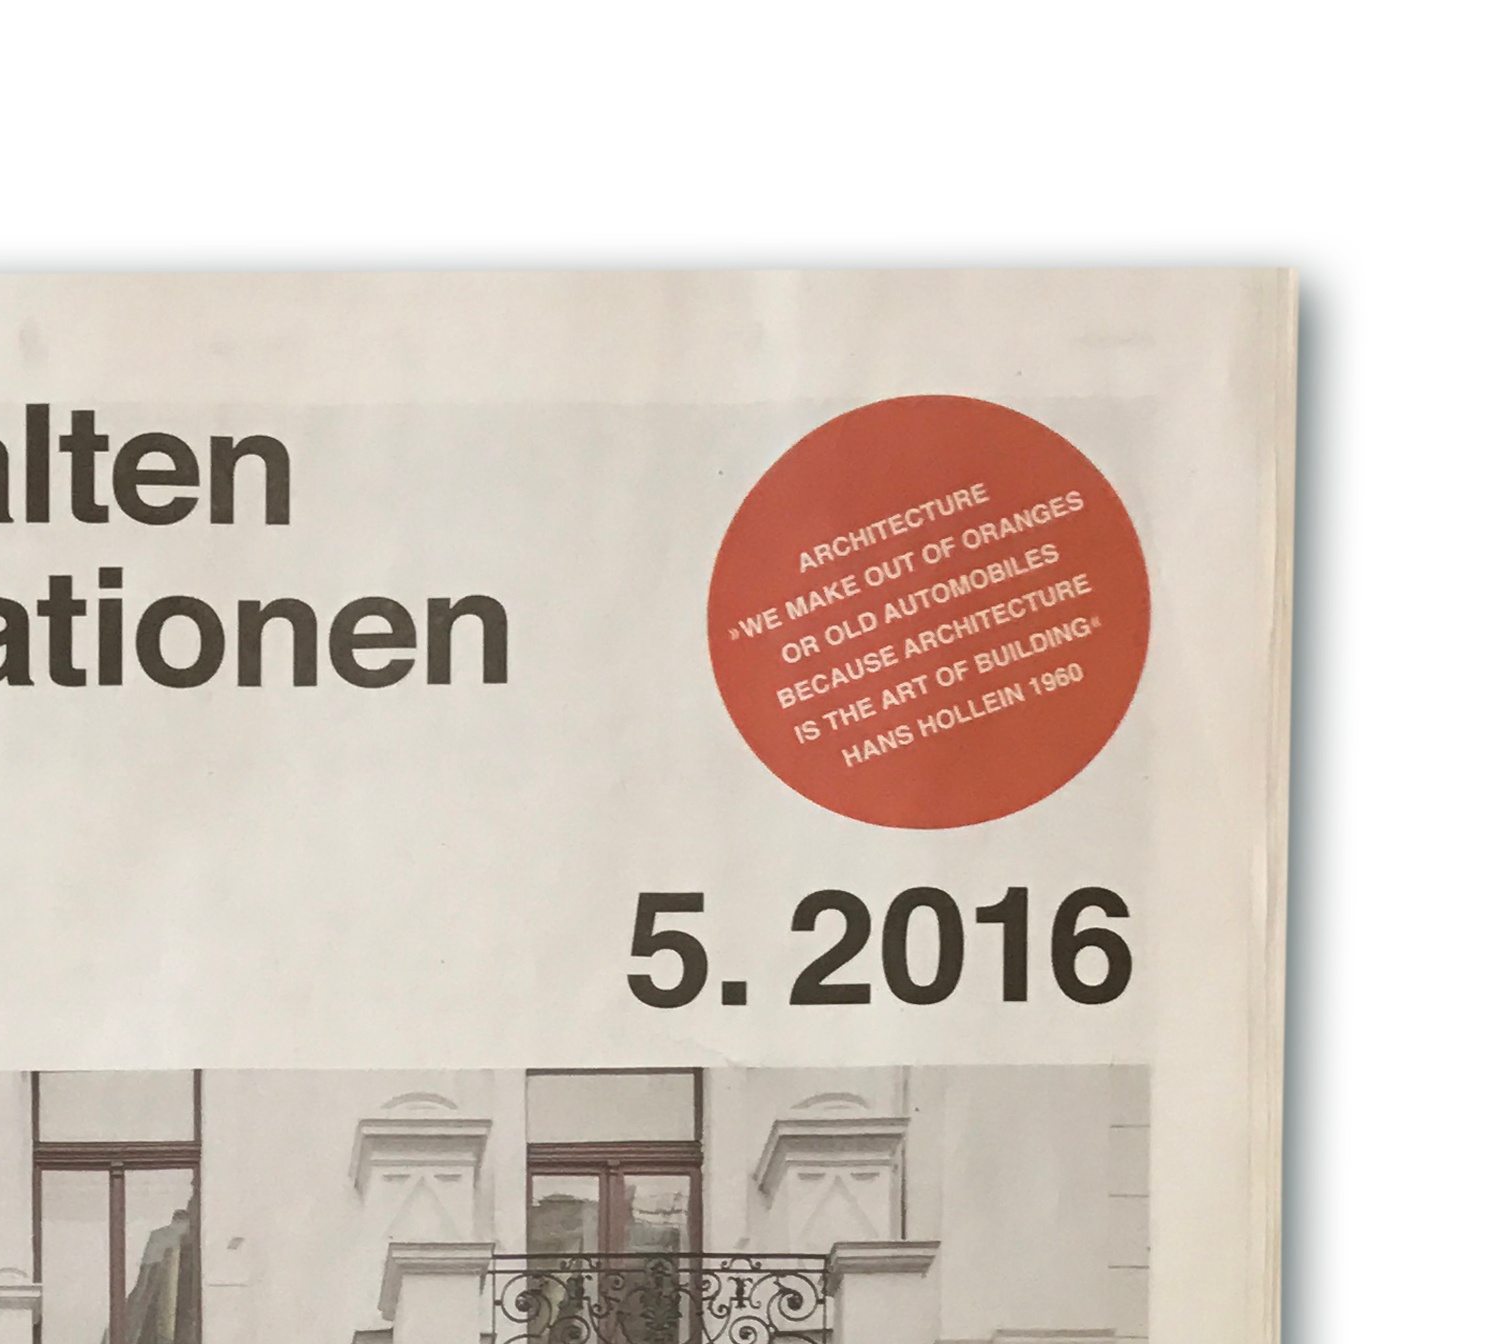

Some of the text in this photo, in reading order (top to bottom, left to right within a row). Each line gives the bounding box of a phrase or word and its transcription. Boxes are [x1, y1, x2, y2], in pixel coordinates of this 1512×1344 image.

[785, 574, 862, 620] MAKE
[864, 551, 915, 587] OUT
[922, 536, 956, 565] OF
[962, 490, 1085, 549] ORANGES
[799, 482, 990, 574] ARCHITECTURE
[776, 573, 1093, 710] BECAUSE ARCHITECTURE
[781, 543, 1060, 664] OR OLD AUTOMOBILES
[793, 720, 821, 745] IS
[822, 697, 878, 731] THE
[881, 674, 929, 711] ART
[935, 659, 970, 688] OF
[841, 662, 1085, 768] HANS HOLLEIN 1960
[628, 887, 1132, 1008] 5. 2016
